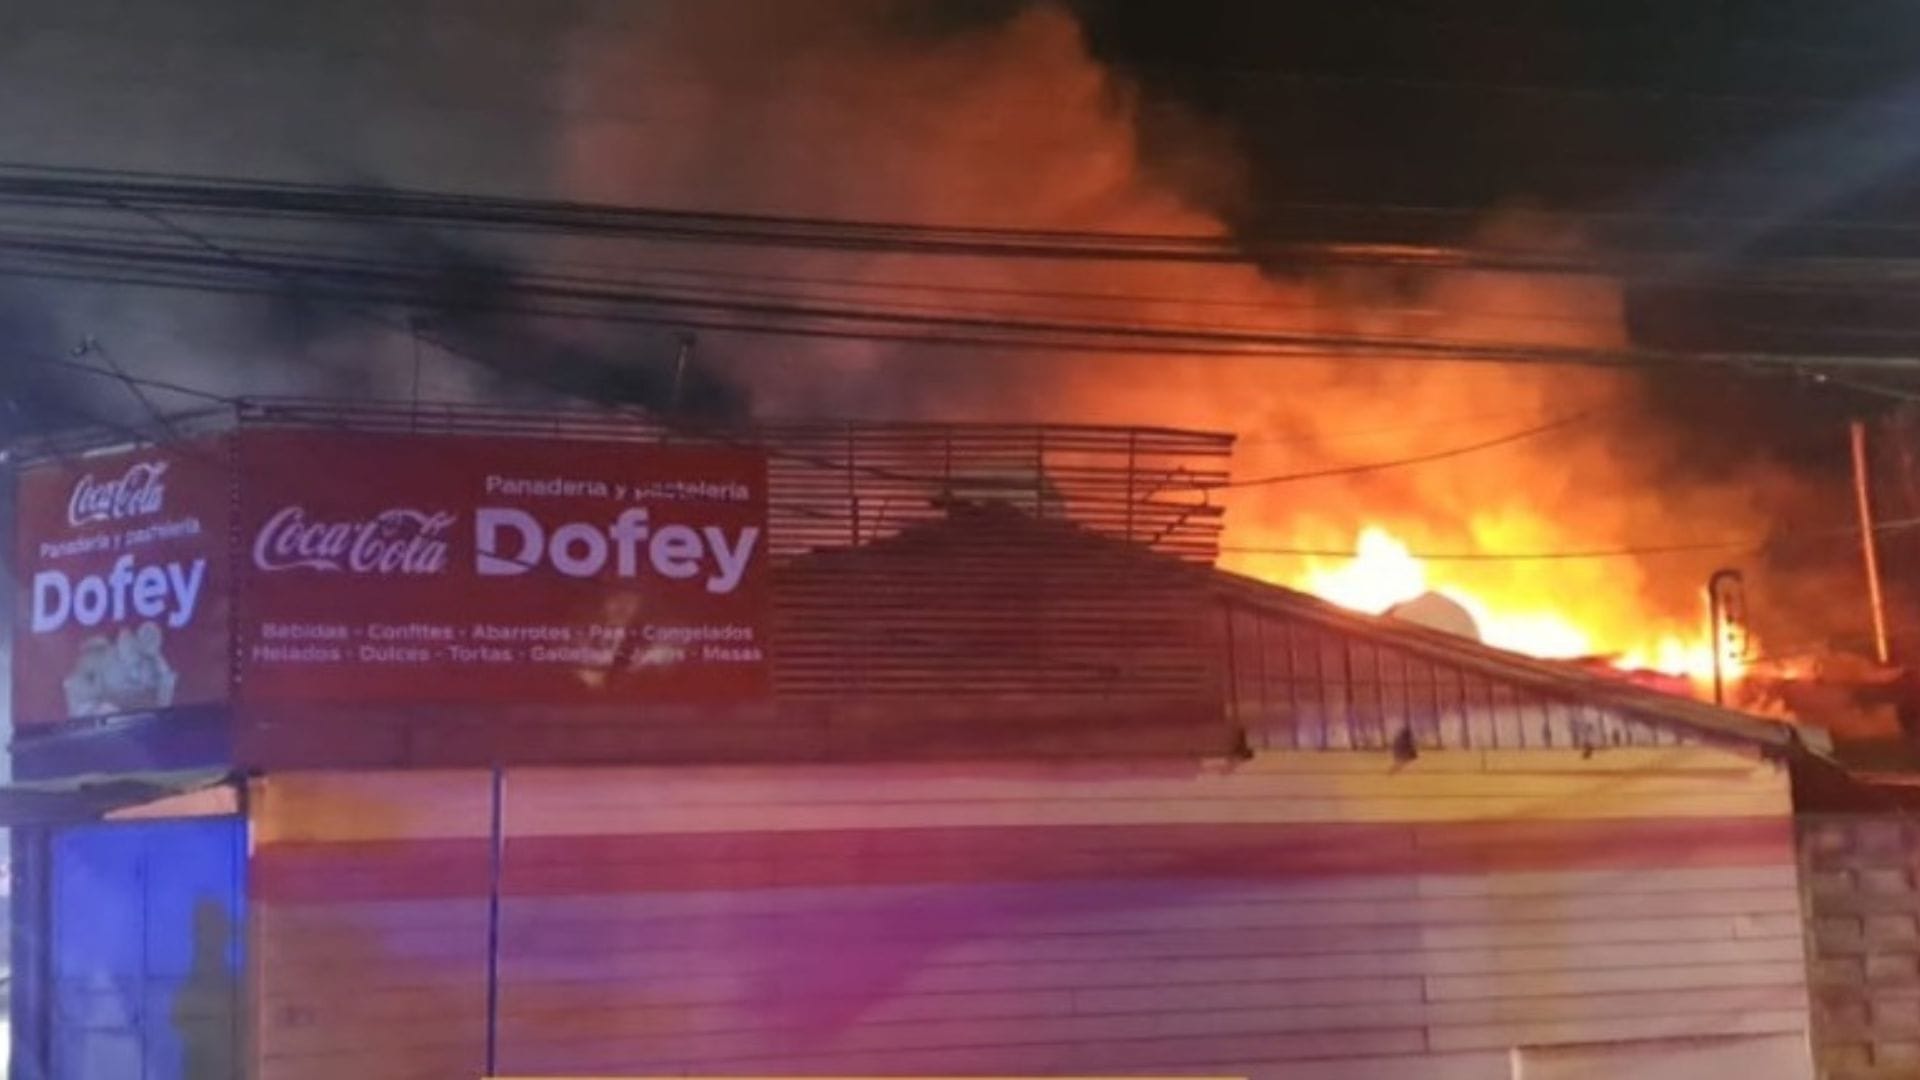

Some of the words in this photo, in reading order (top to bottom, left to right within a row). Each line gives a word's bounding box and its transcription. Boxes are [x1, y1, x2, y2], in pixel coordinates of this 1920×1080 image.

[614, 484, 627, 500] y
[475, 507, 759, 593] Dofey
[32, 554, 206, 633] Dofey
[262, 623, 347, 639] Bebidas
[368, 623, 453, 639] Confites
[472, 624, 570, 640] Abarrotes
[642, 625, 753, 643] Congelados
[253, 645, 340, 661] Helados
[360, 645, 429, 661] Dulces
[449, 645, 512, 661] Tortas
